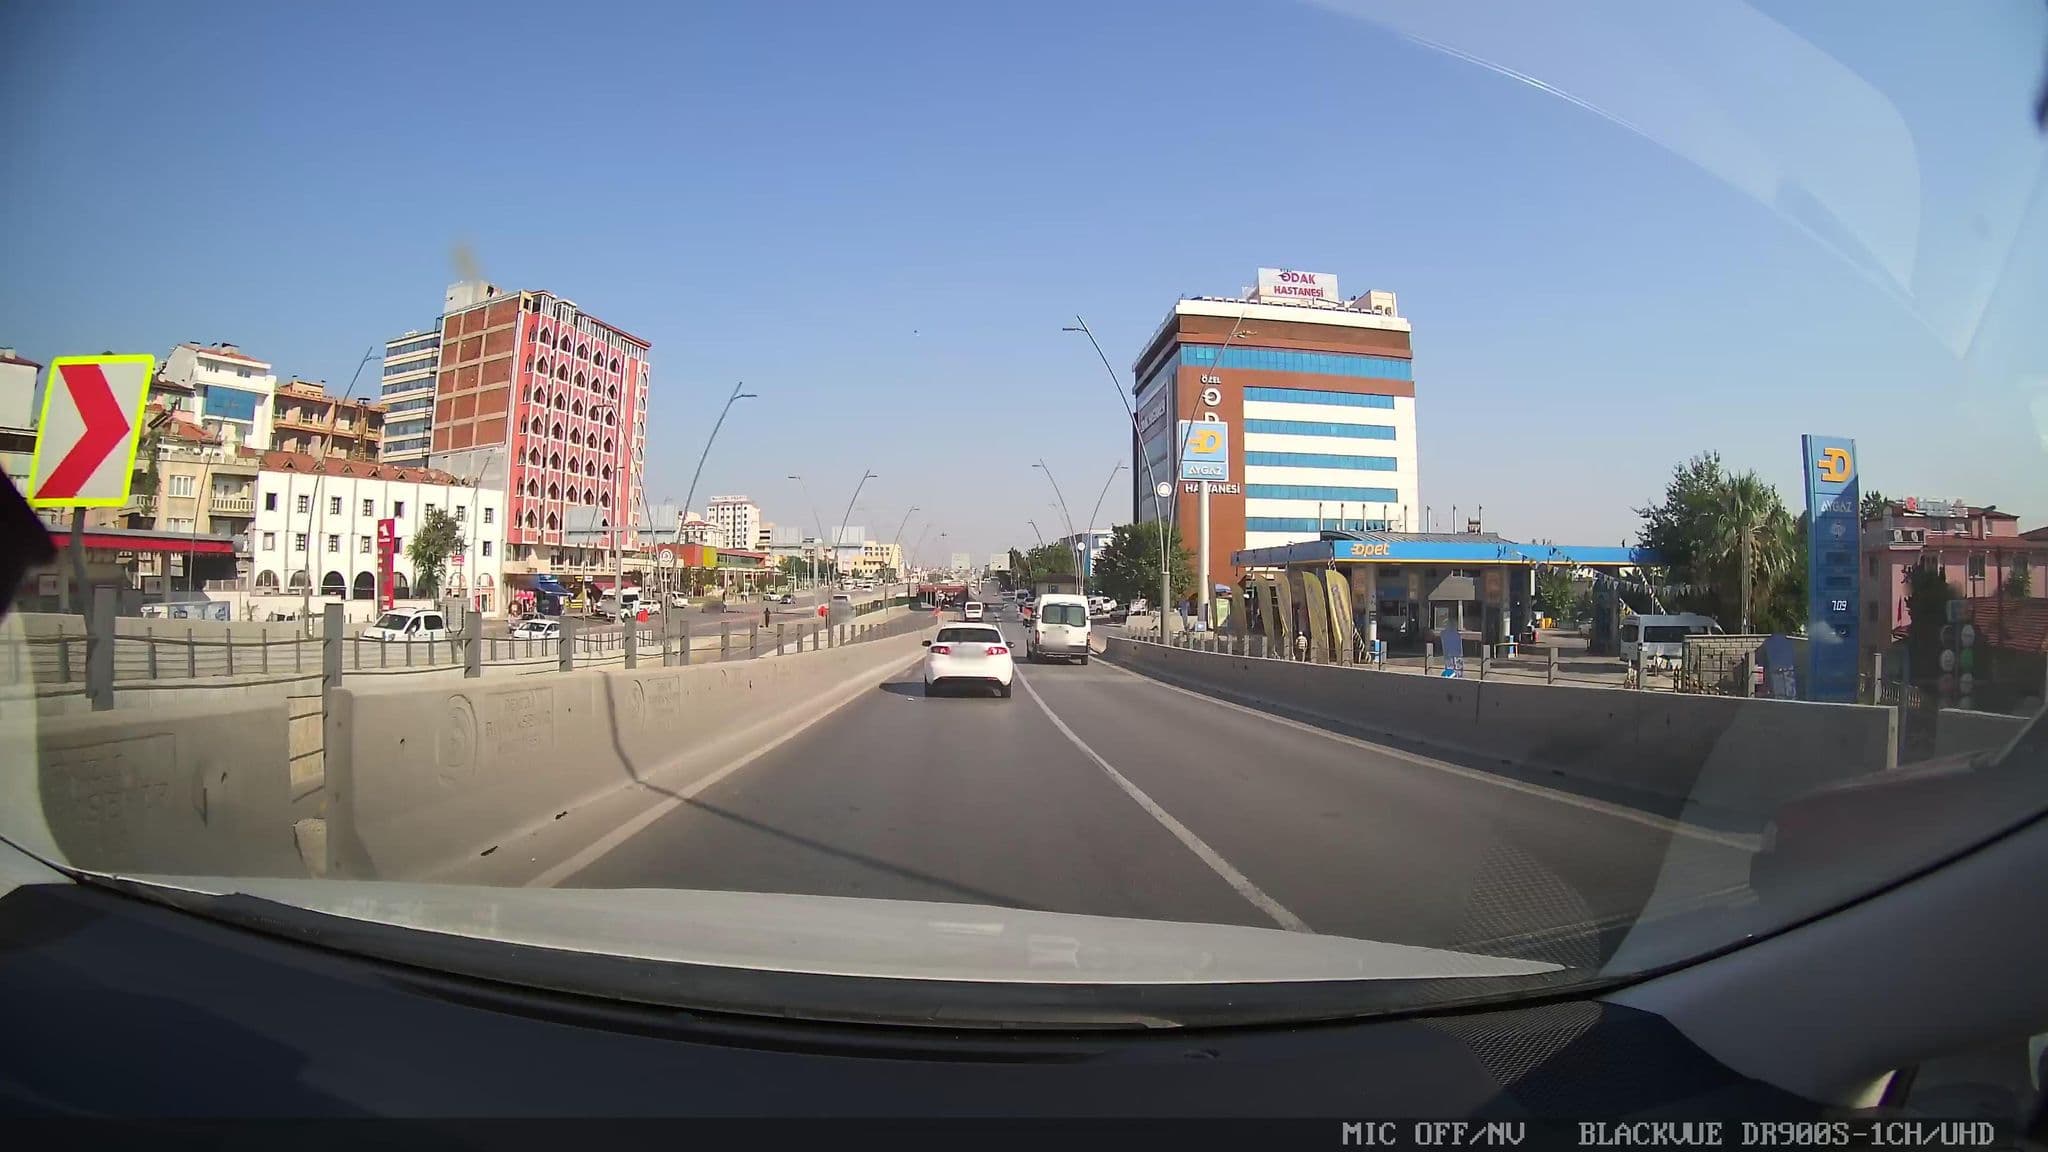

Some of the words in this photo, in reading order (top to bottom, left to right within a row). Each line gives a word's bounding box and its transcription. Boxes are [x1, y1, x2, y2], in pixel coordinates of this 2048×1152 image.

[1279, 272, 1316, 284] ODAK
[1274, 285, 1324, 297] HASTANESİ
[1188, 465, 1223, 475] AYGAZ
[1185, 483, 1240, 494] HATANESİ
[1821, 499, 1852, 512] AYGAZ
[1350, 543, 1390, 557] opet
